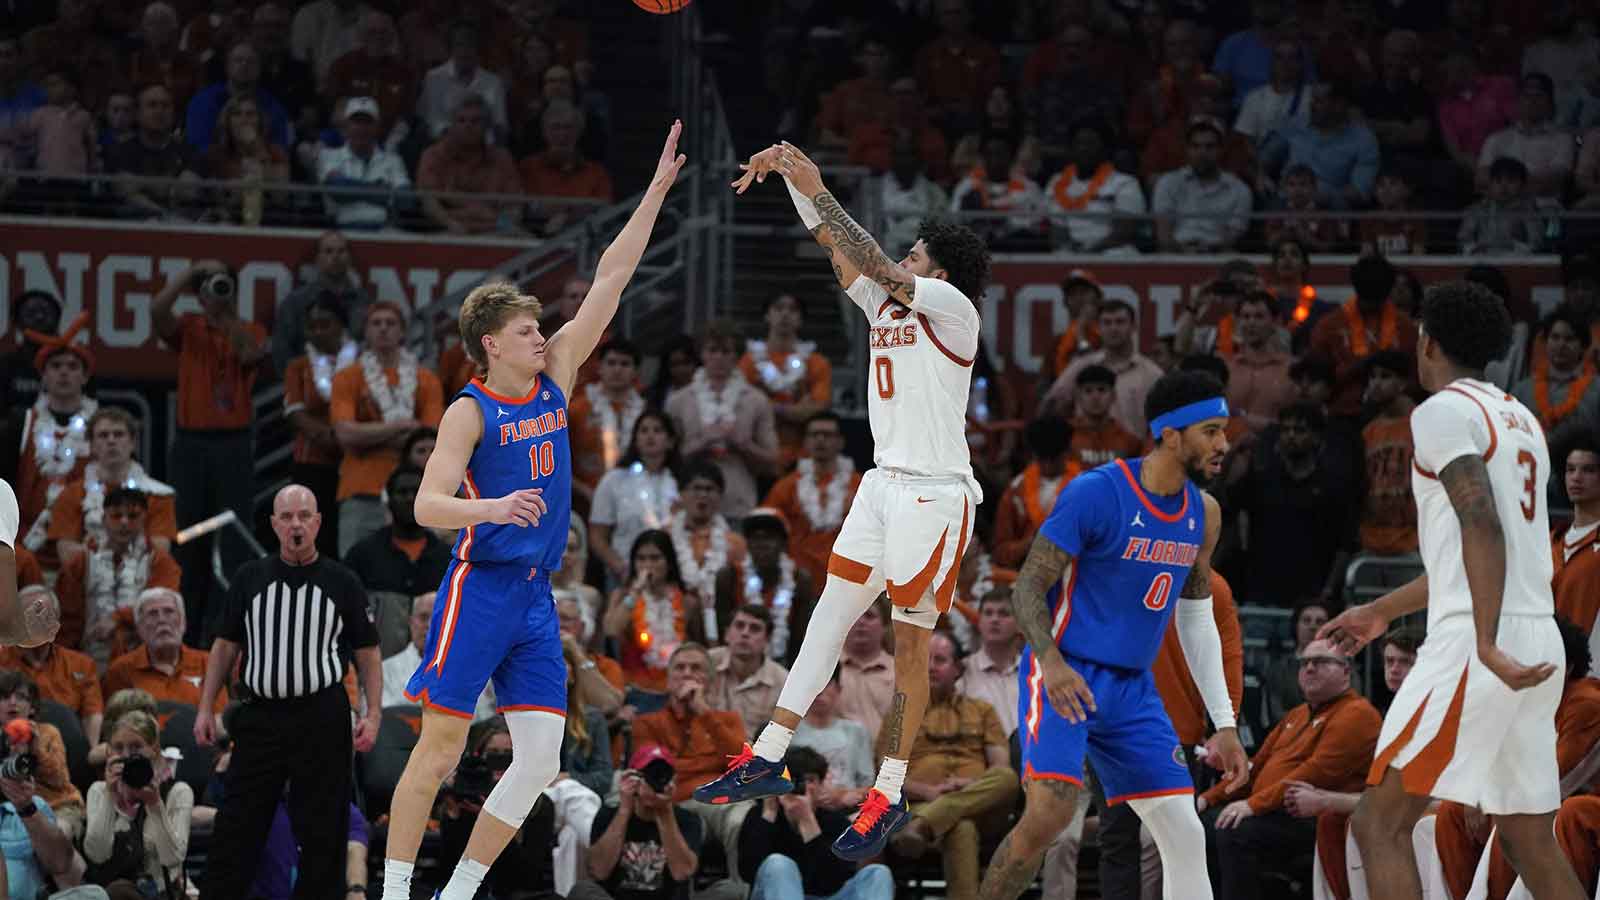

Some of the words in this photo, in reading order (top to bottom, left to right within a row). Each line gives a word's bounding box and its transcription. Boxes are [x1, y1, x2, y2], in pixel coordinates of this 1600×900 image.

[874, 353, 895, 400] 0
[498, 408, 568, 446] FLORIDA
[529, 440, 554, 480] 10
[1518, 448, 1537, 522] 3
[1143, 572, 1173, 611] 0
